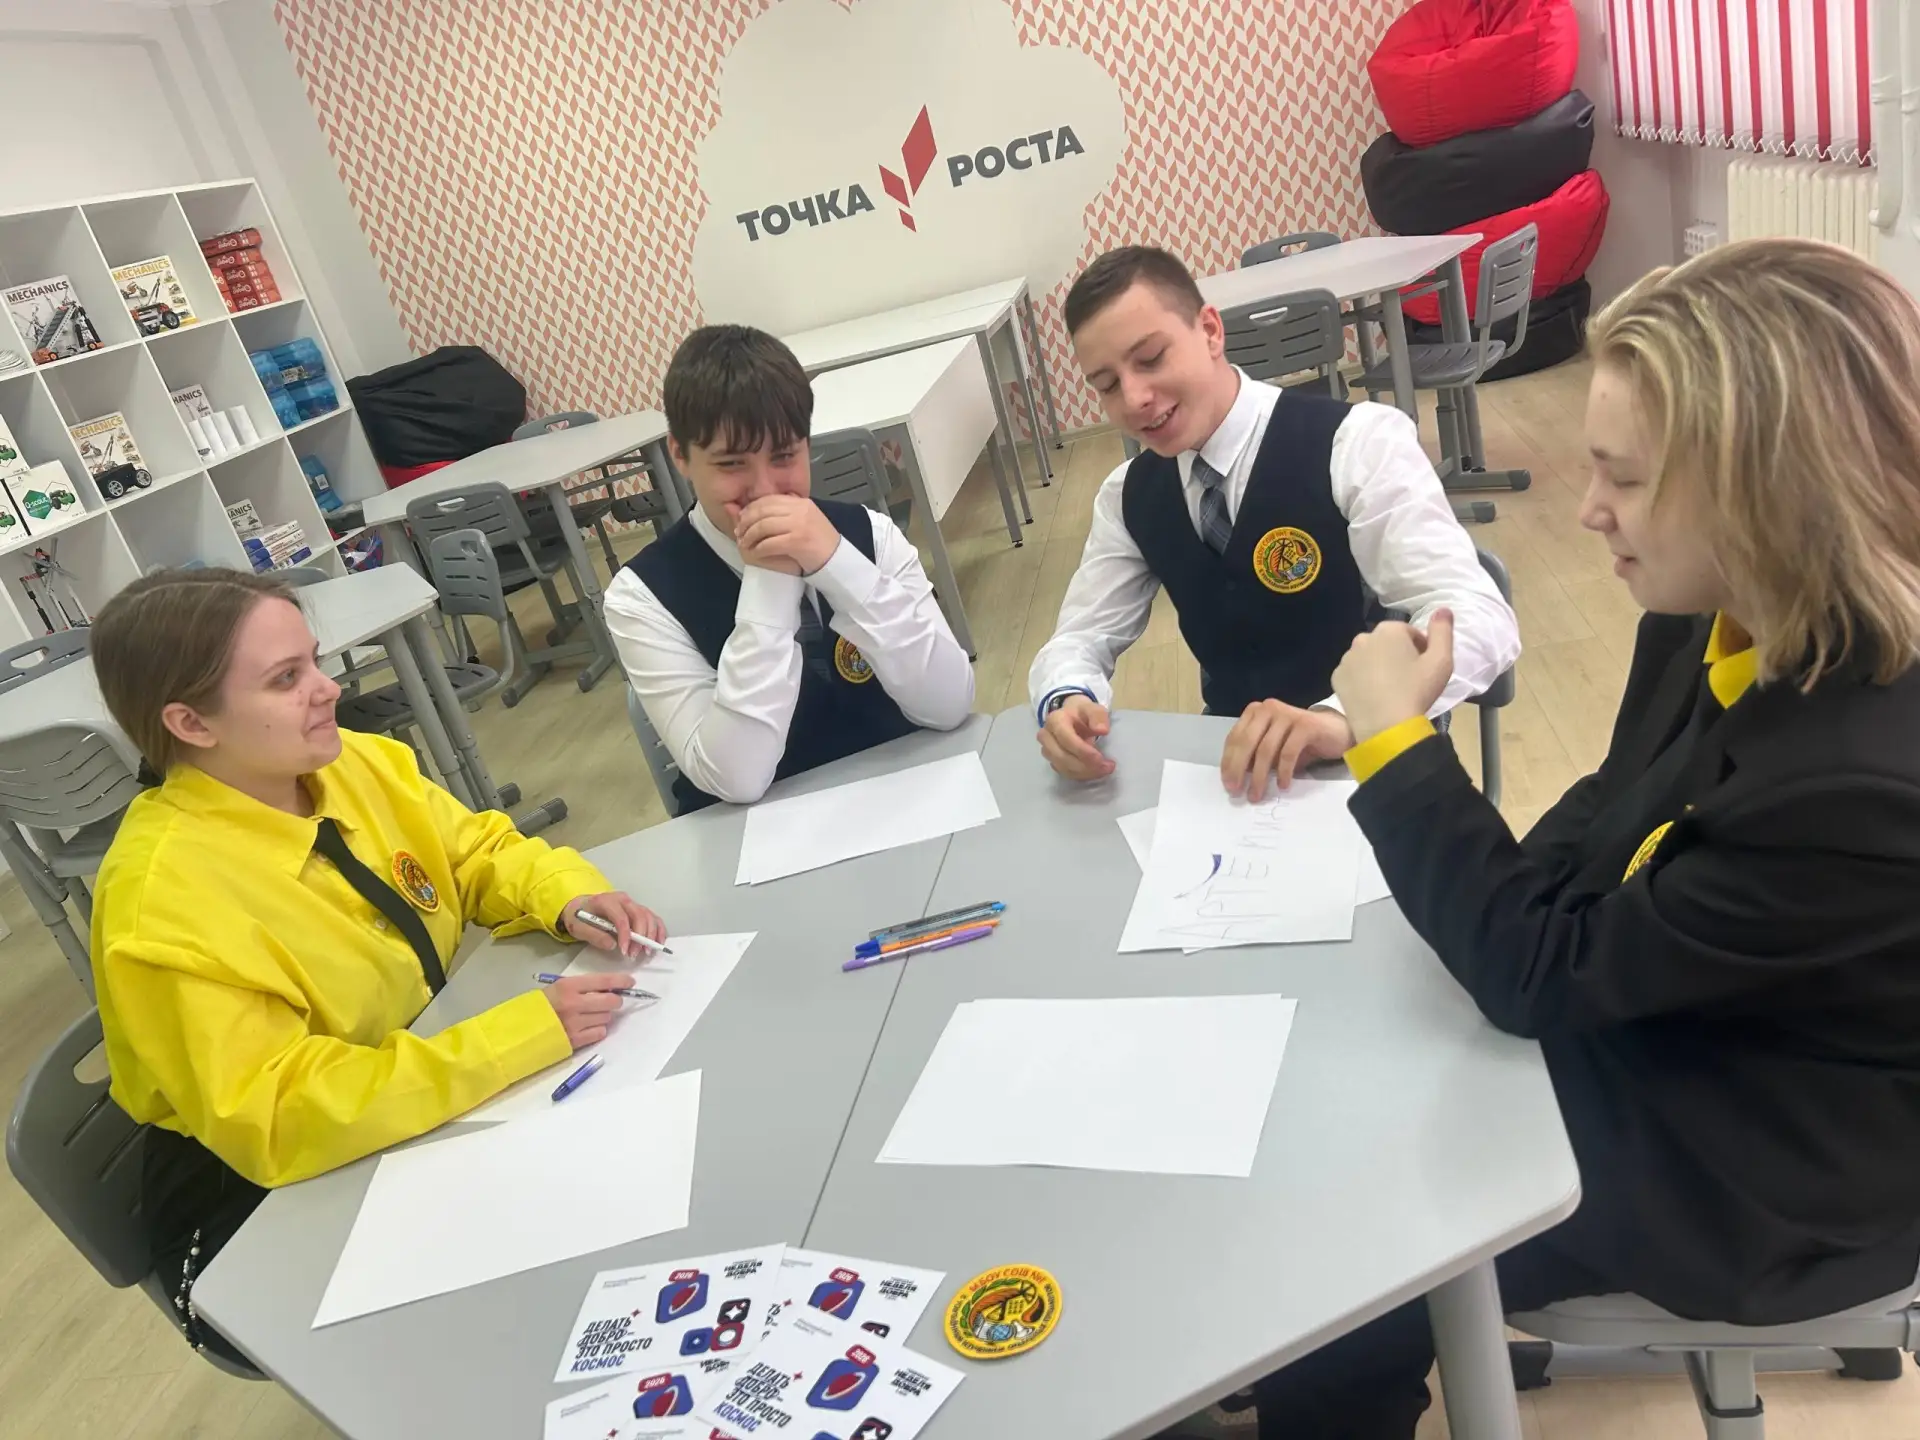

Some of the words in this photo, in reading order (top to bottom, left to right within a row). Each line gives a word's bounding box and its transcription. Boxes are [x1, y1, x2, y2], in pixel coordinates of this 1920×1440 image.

[736, 184, 875, 242] ТОЧКА
[946, 125, 1085, 188] РОСТА
[112, 260, 170, 280] MECHANICS
[7, 281, 69, 303] MECHANICS
[172, 389, 203, 404] HANICS
[583, 1317, 632, 1334] ДЕЛАТЬ
[575, 1343, 600, 1359] ЭТО
[602, 1337, 653, 1355] ПРОСТО
[570, 1353, 626, 1373] КОСМОС
[747, 1362, 791, 1389] ДЕЛАТЬ
[713, 1401, 762, 1433] КОСМОС
[725, 1386, 750, 1406] ЭТО
[745, 1398, 792, 1428] ПРОСТО
